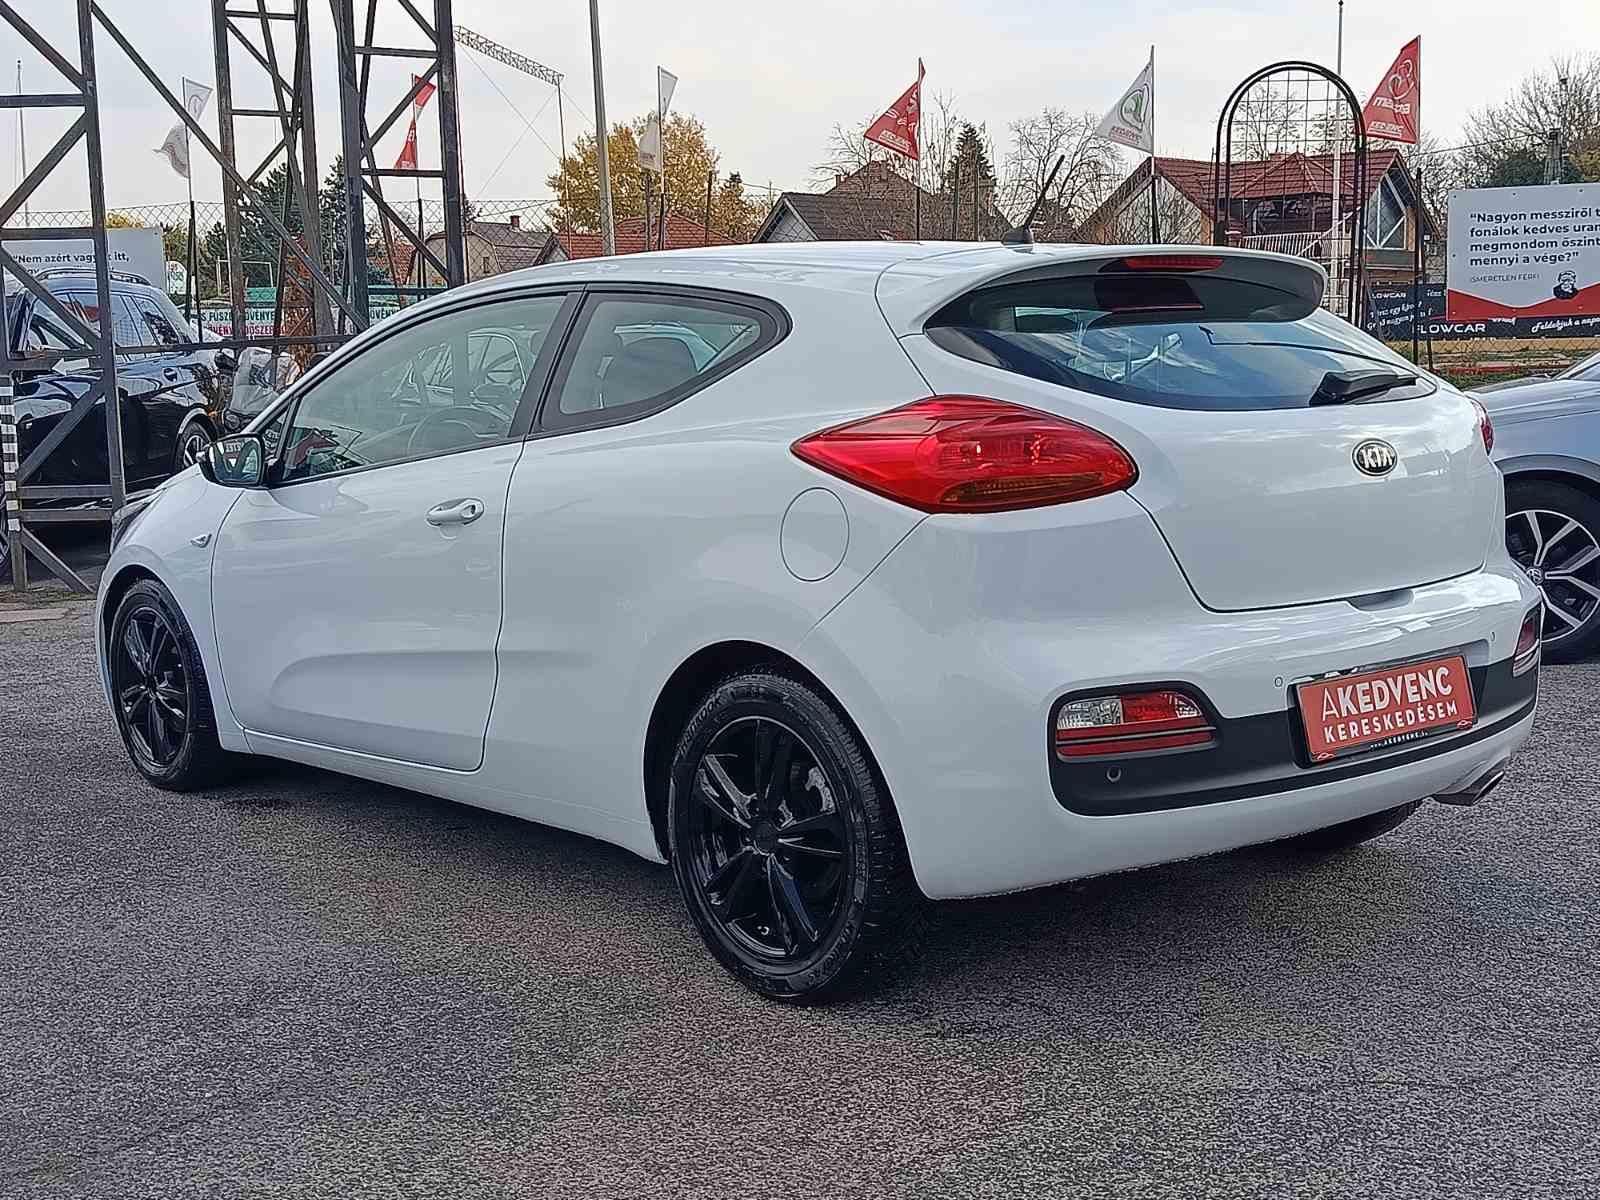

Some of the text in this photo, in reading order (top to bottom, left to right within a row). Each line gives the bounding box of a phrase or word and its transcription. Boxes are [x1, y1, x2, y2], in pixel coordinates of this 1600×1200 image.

[1530, 208, 1592, 220] messziről
[1470, 227, 1520, 237] fonálok
[1523, 225, 1570, 235] kedves
[1470, 239, 1557, 253] megmondom
[1470, 254, 1519, 266] mennyi
[1522, 255, 1530, 264] a
[1360, 446, 1393, 469] KIA
[1322, 667, 1453, 721] AKEDVENC
[1323, 699, 1459, 744] KERESKEDÉSEM
